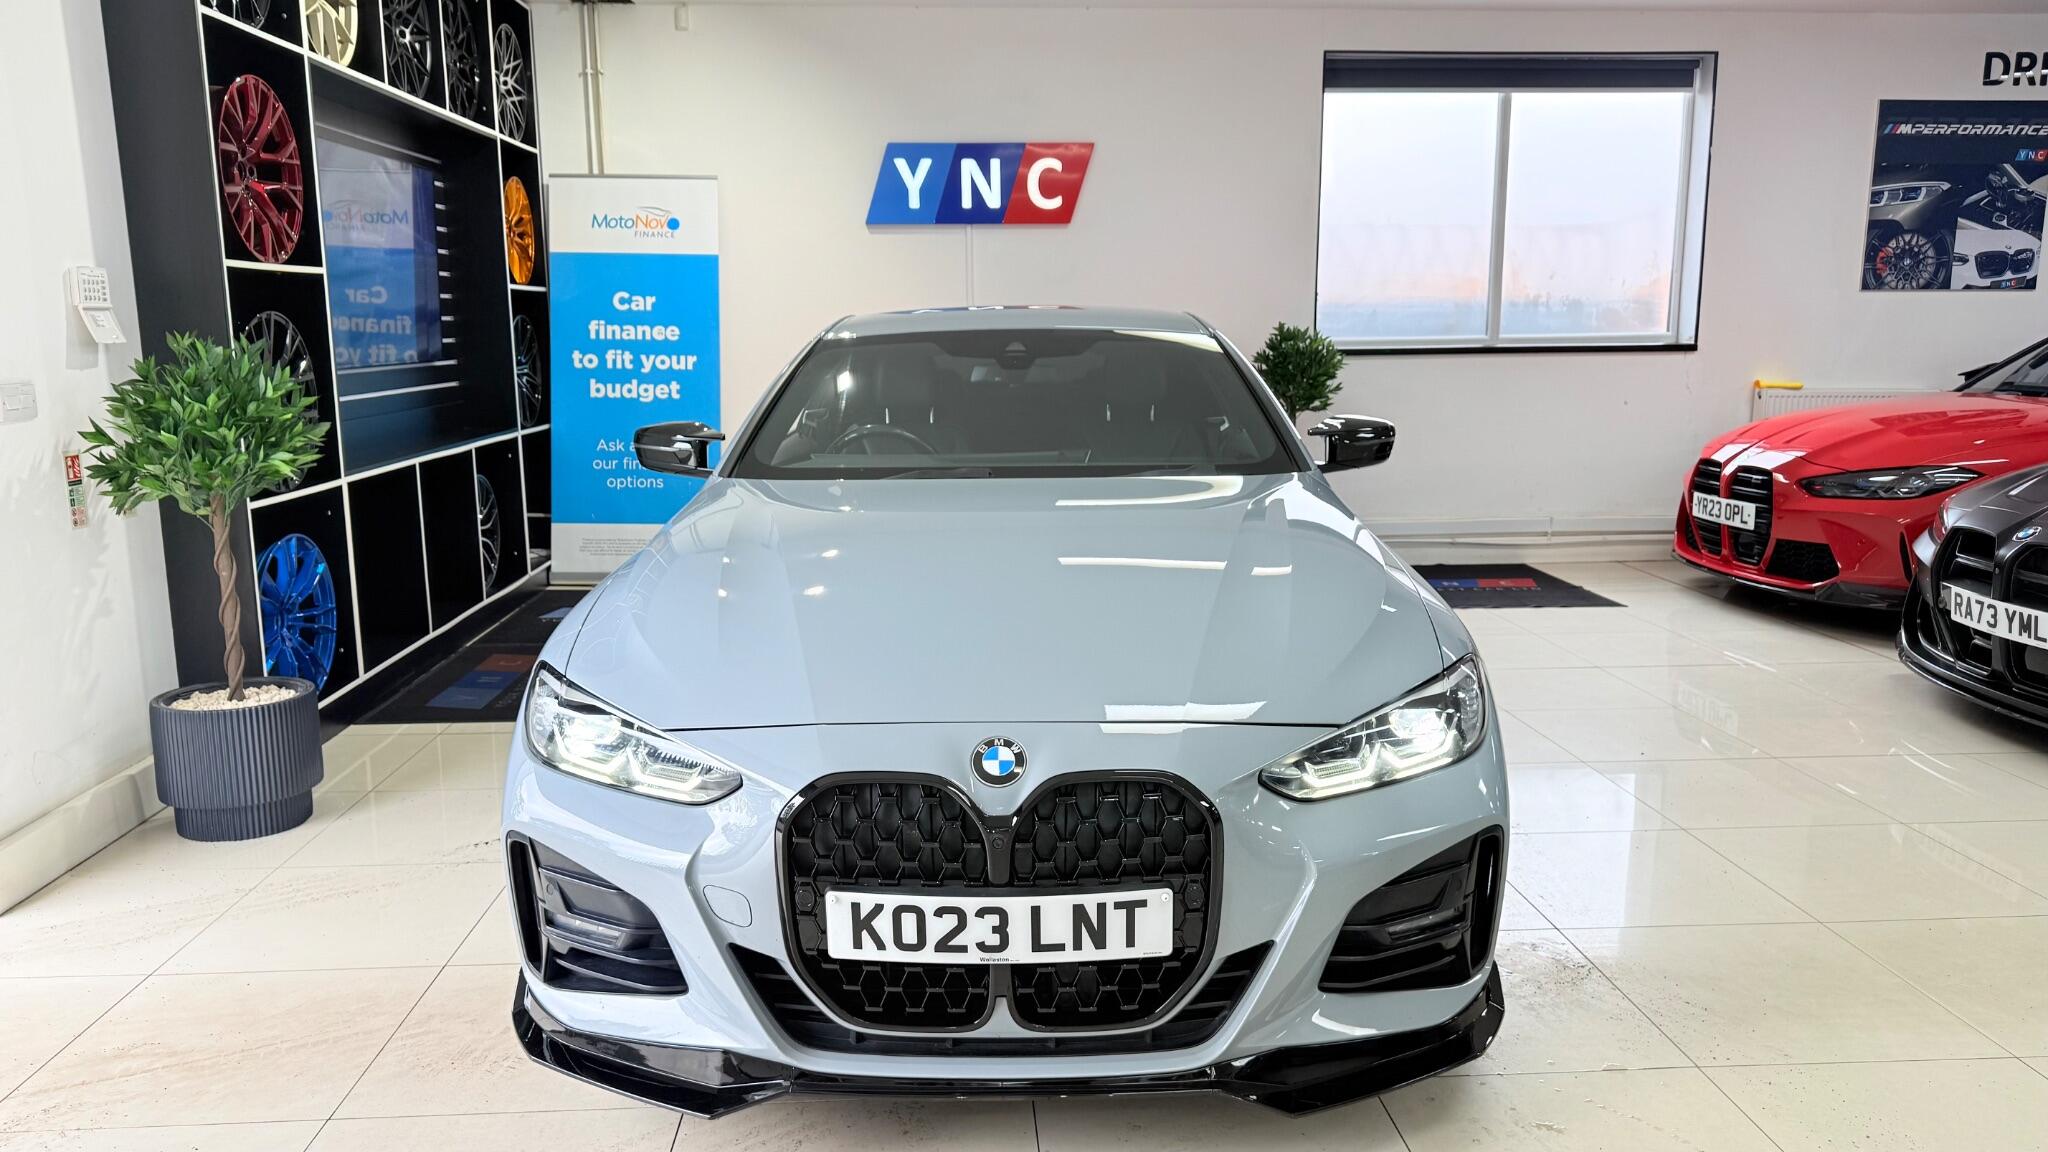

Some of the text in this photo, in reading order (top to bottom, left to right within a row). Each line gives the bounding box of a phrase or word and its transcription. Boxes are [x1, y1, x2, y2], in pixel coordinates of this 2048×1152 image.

[2019, 151, 2044, 160] YNC
[892, 156, 1063, 211] YNC
[634, 230, 675, 239] FINANCE
[612, 291, 656, 311] Car
[588, 320, 680, 341] finance
[572, 349, 698, 374] to fit your
[589, 378, 681, 403] budget
[596, 438, 625, 452] Ask
[592, 459, 618, 470] our
[606, 475, 664, 490] options
[1696, 495, 1748, 525] YR23 OPL
[1954, 591, 2048, 643] RA73 YML
[977, 738, 1021, 754] BMW
[850, 898, 1148, 955] KO23 LNT
